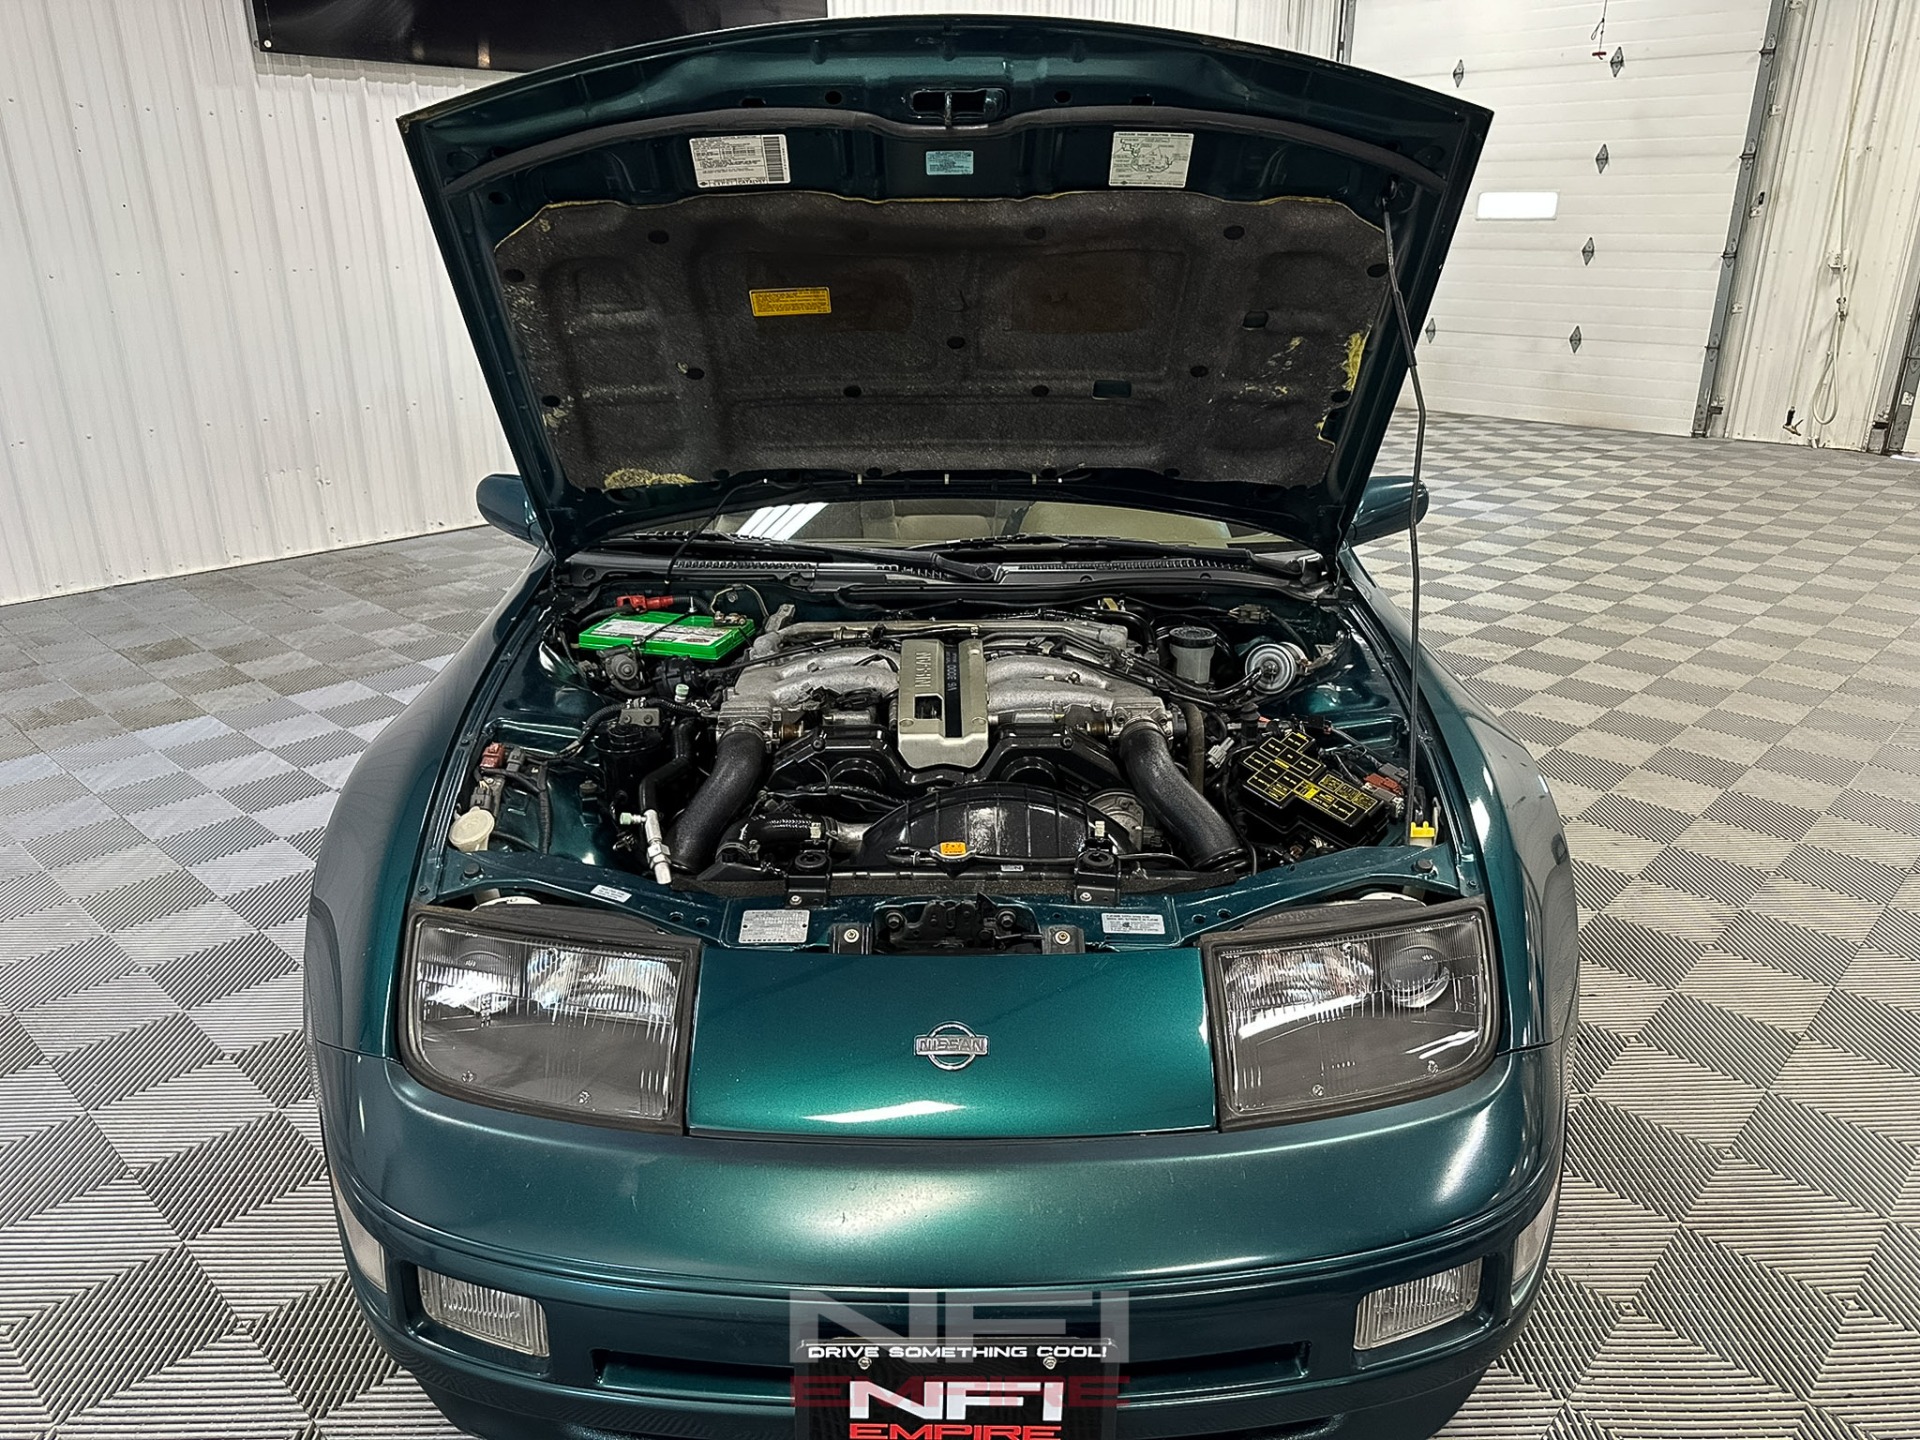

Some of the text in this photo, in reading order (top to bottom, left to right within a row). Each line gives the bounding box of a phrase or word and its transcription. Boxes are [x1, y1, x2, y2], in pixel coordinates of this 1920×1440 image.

[914, 651, 931, 688] NISSAN
[946, 664, 957, 680] 3000
[916, 1038, 987, 1053] NISSAN
[807, 1346, 1107, 1359] DRIVE SOMETHING COOL!
[849, 1380, 1064, 1421] NFI
[849, 1423, 1062, 1440] EMPIRE
